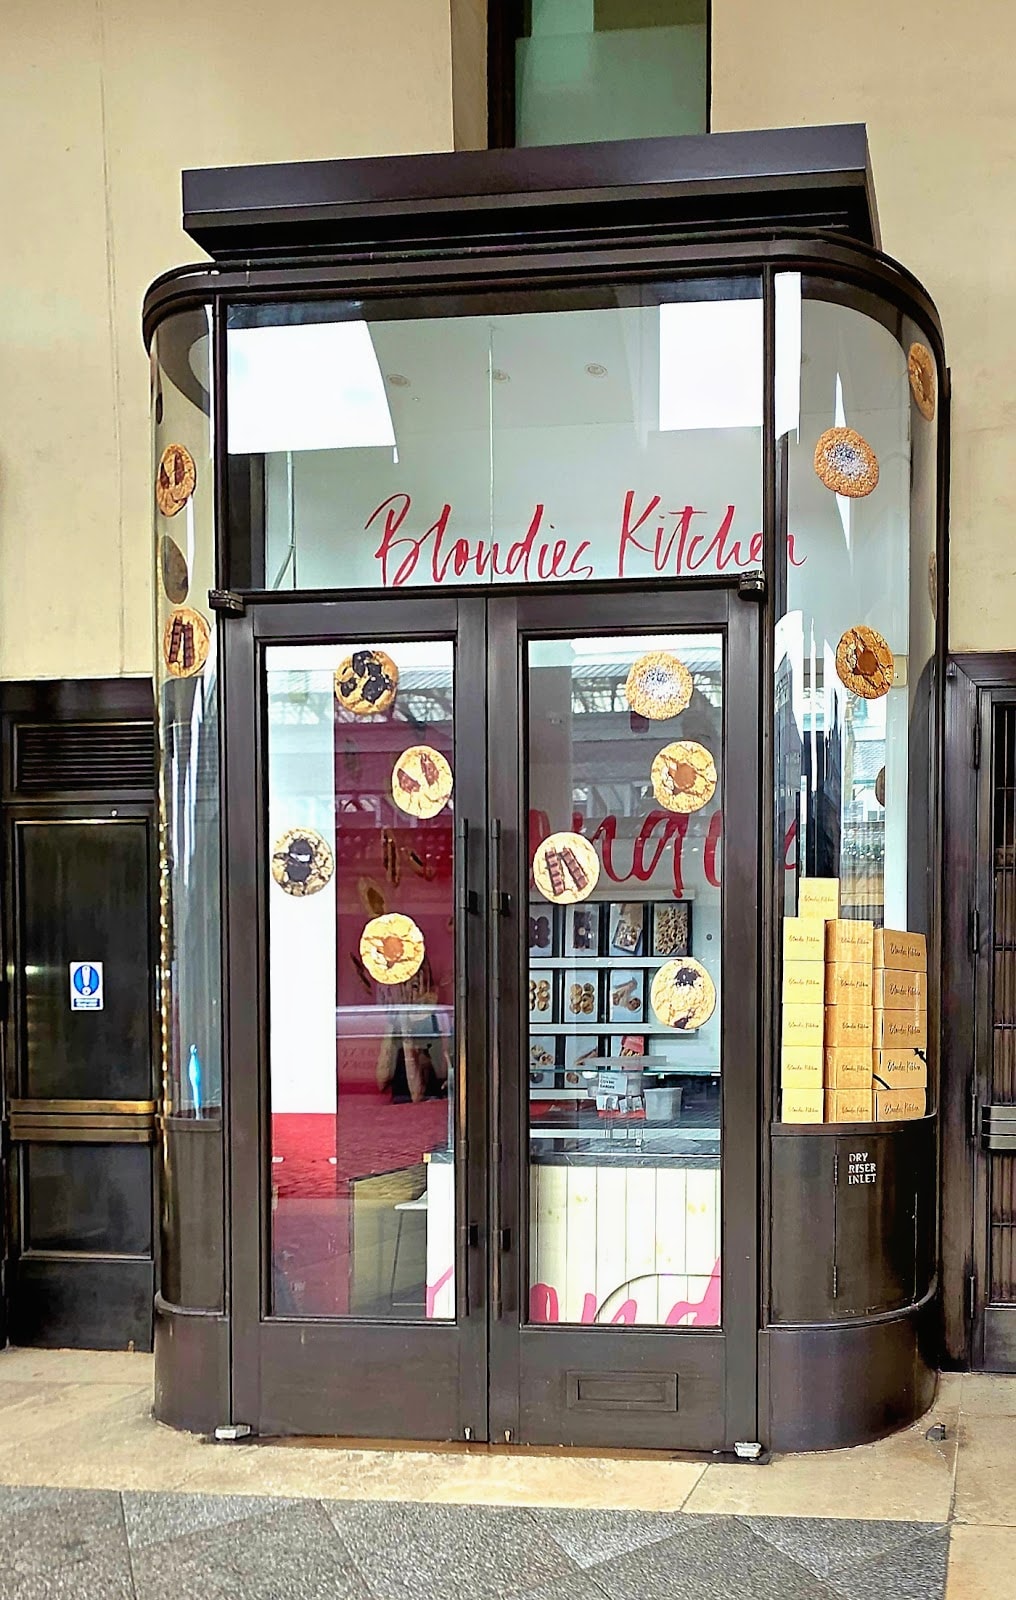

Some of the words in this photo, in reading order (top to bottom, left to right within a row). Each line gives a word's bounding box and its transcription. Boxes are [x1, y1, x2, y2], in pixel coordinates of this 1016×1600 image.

[365, 493, 592, 588] Blondies
[619, 490, 808, 577] Kitchen
[848, 1152, 868, 1162] DRY
[848, 1162, 876, 1173] RISER
[848, 1173, 877, 1185] INLET
